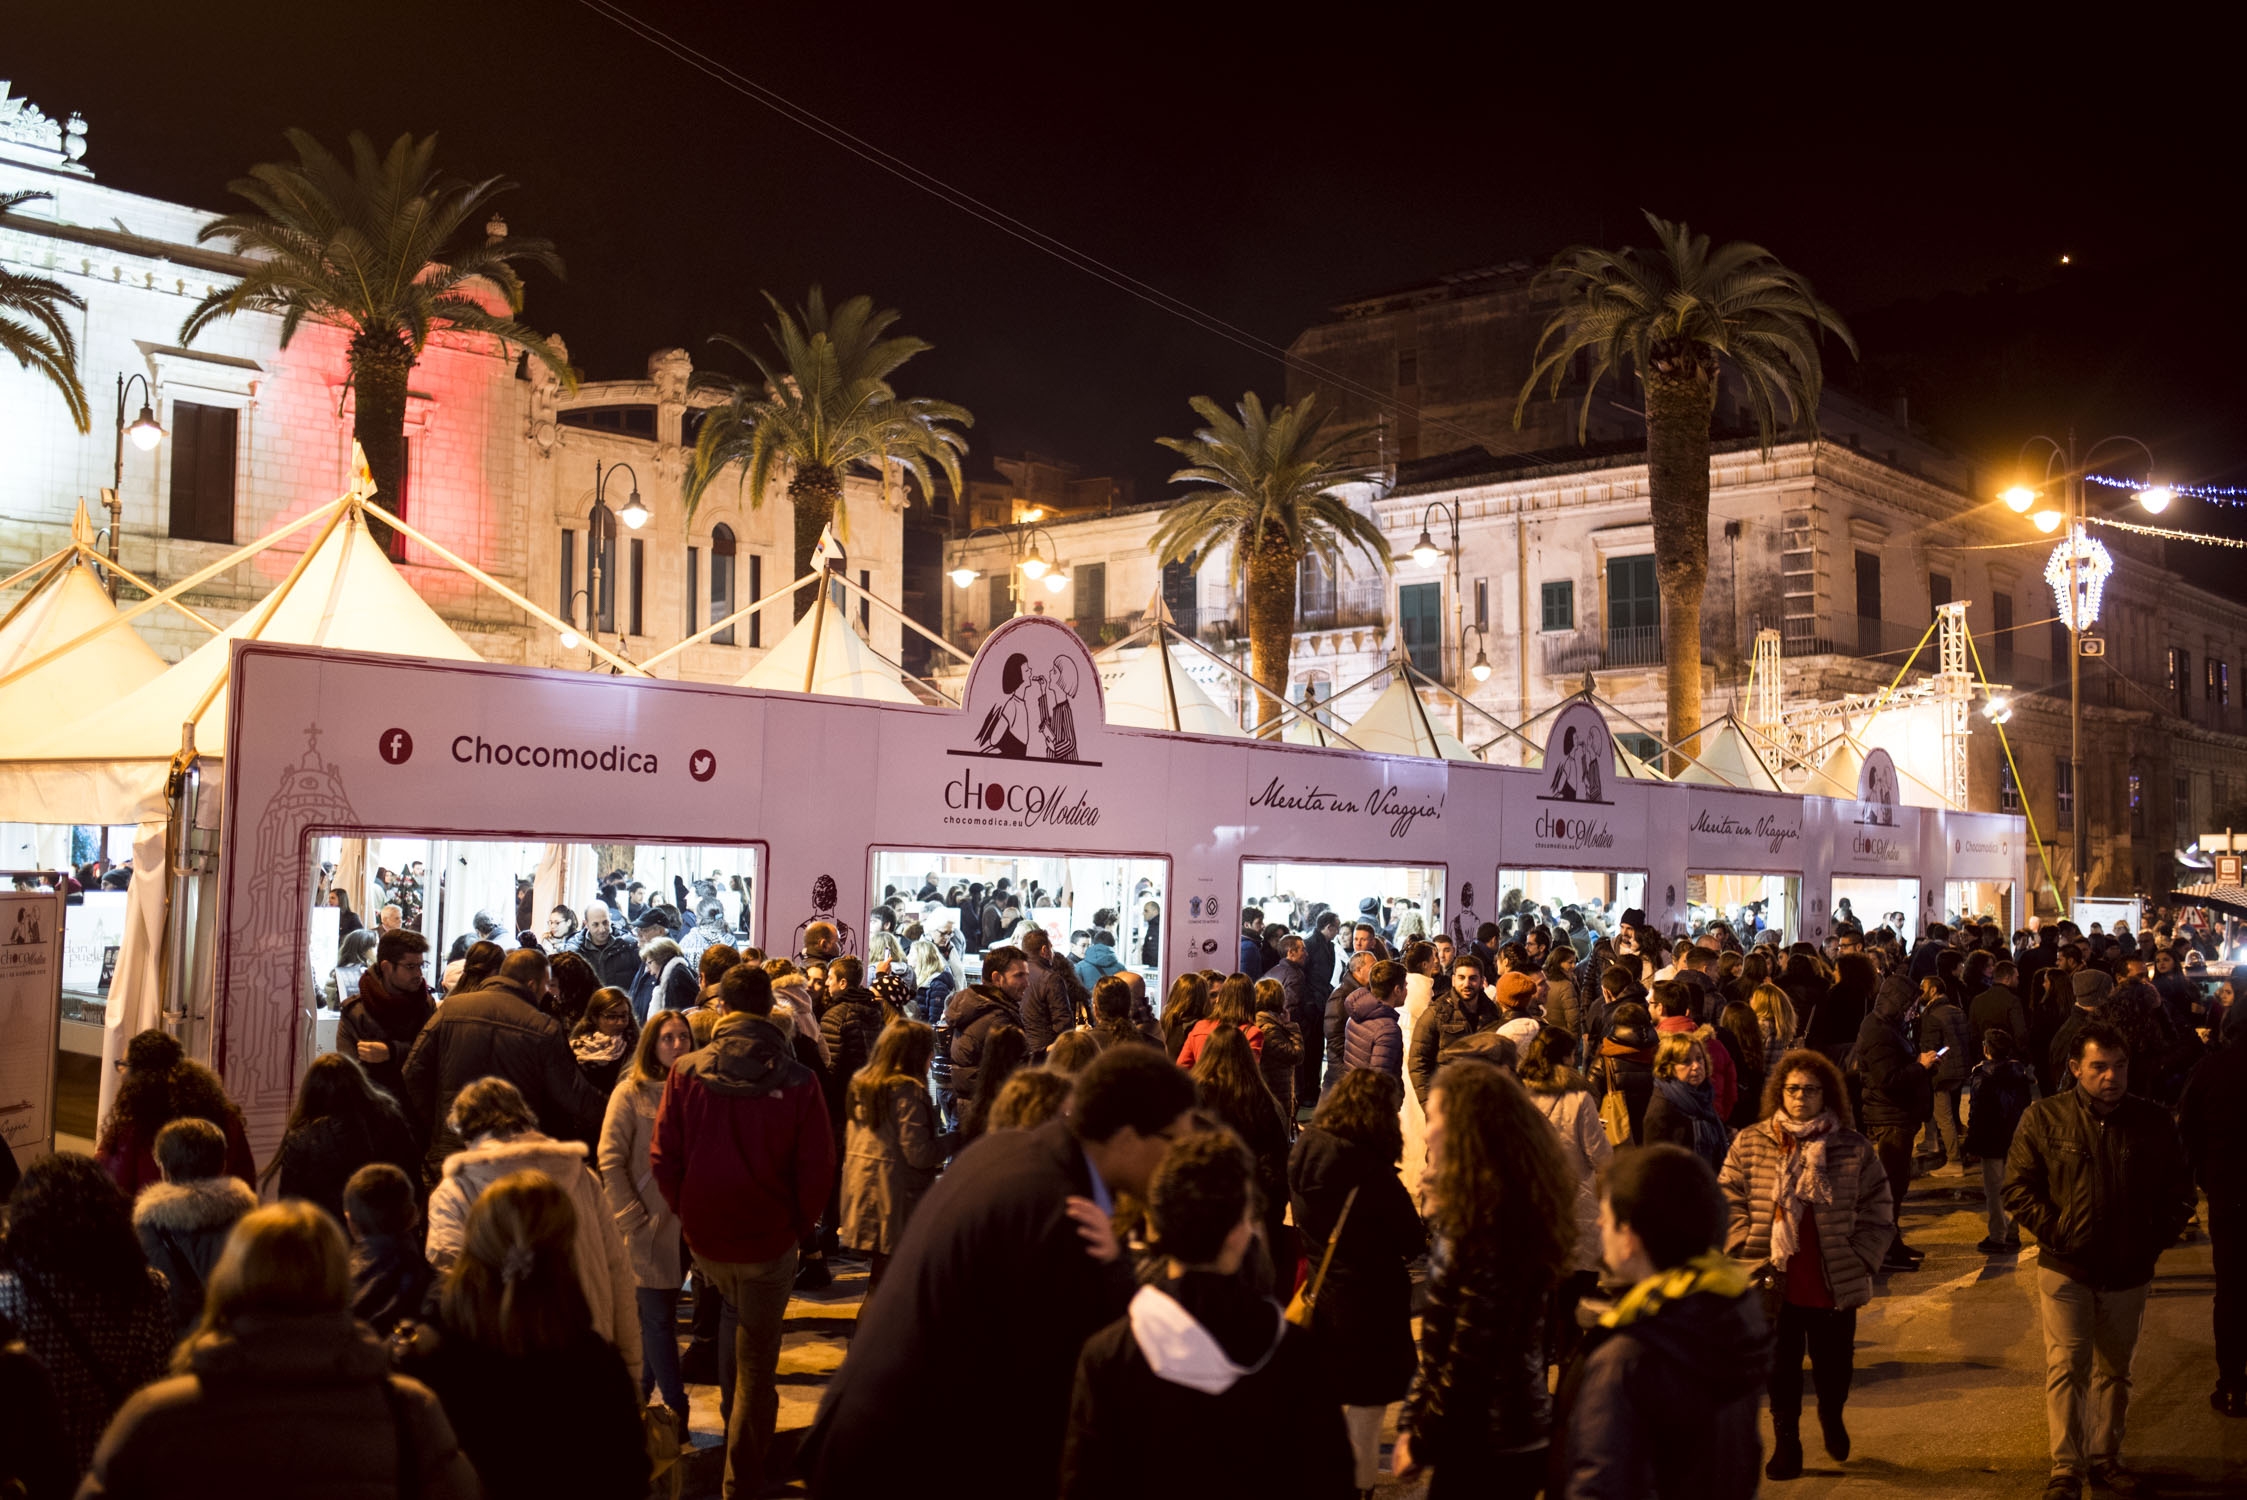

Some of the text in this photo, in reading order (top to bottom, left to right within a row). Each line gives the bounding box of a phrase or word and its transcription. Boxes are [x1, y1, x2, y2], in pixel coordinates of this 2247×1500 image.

[451, 735, 659, 774] Chocomodica
[943, 816, 1024, 828] chocomodica.eu
[1024, 784, 1101, 828] Modica
[1249, 776, 1446, 838] Merita un Viaggio!
[1690, 809, 1804, 854] Merita un Viaggio!
